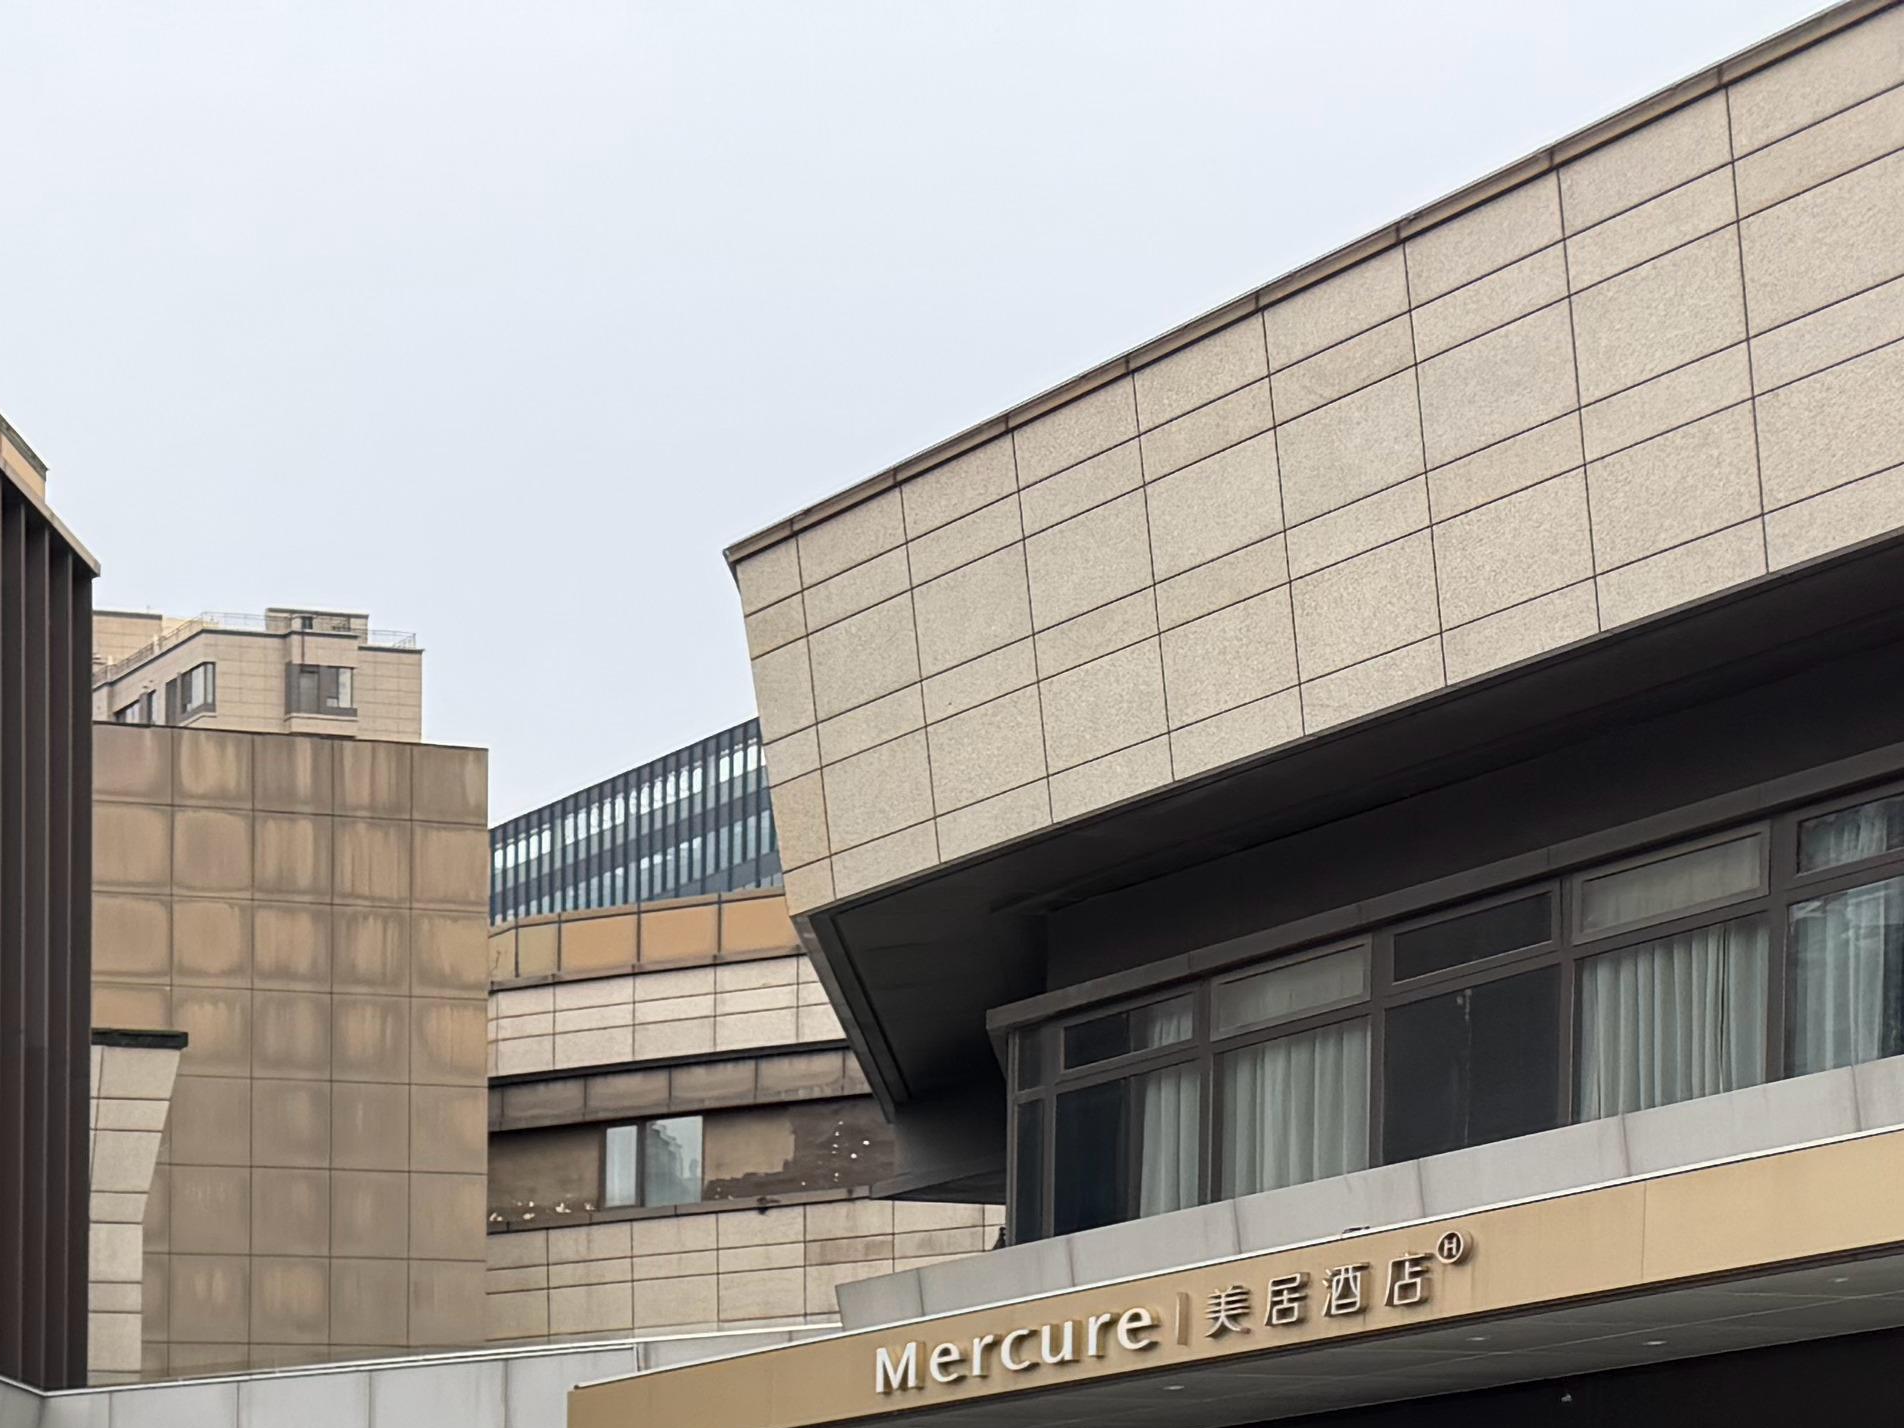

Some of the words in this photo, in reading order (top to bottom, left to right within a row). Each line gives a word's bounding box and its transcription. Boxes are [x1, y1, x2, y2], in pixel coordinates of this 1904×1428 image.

[875, 1306, 1155, 1394] Mercure
[1205, 1250, 1432, 1340] 美居酒店
